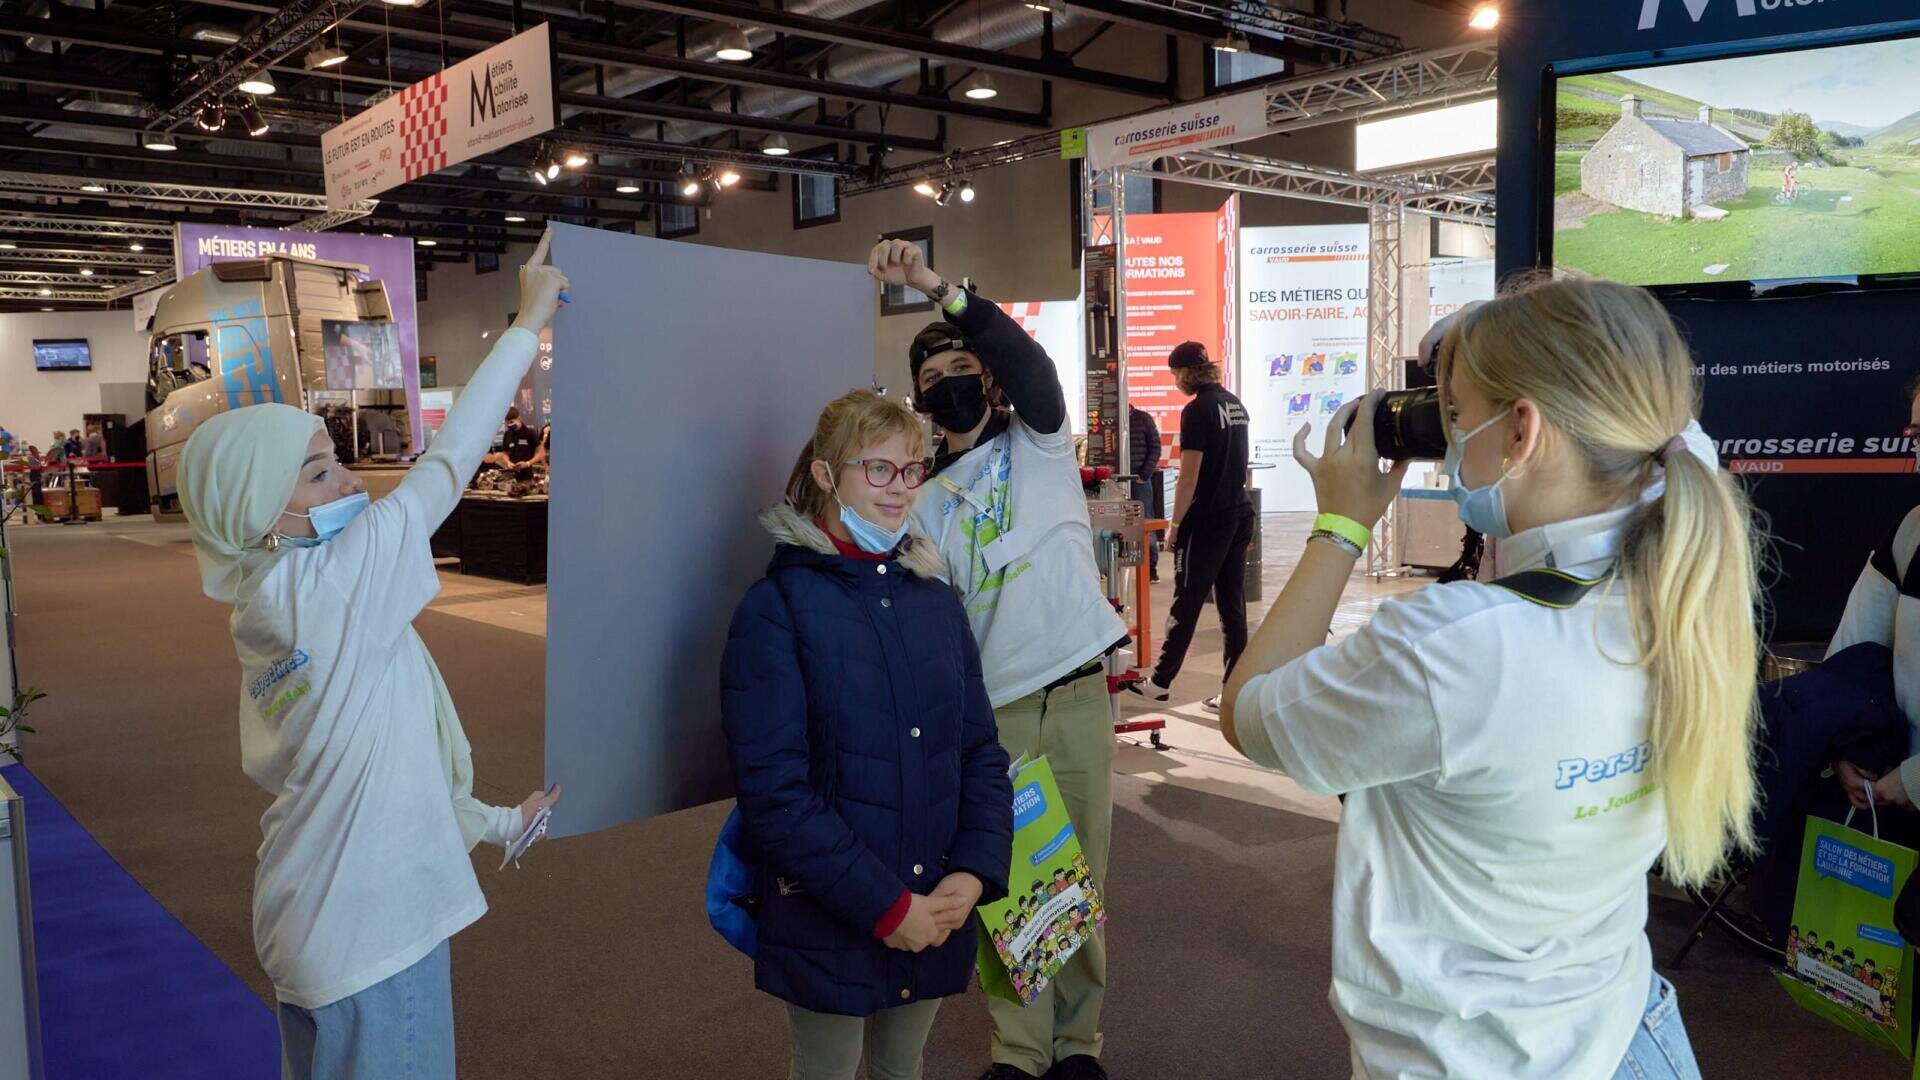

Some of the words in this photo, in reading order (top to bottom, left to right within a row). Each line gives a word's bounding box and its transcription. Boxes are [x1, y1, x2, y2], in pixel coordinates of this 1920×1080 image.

[332, 142, 350, 161] FUTUR
[350, 135, 361, 152] EST
[361, 132, 370, 147] EN
[370, 119, 396, 141] ROUTES
[1115, 121, 1178, 147] carrosserie
[1180, 113, 1220, 133] suisse
[198, 235, 257, 258] MÉTIERS
[258, 241, 276, 255] EN
[290, 243, 316, 260] ANS
[1250, 243, 1316, 255] carrosserie
[1319, 240, 1358, 253] suisse
[1125, 257, 1156, 267] UTES
[1158, 256, 1184, 267] NOS
[1125, 268, 1185, 279] RMATIONS
[1249, 290, 1277, 304] DES
[1280, 286, 1343, 302] MÉTIERS
[1347, 288, 1369, 300] QU
[1710, 363, 1738, 376] des
[1742, 360, 1803, 375] métiers
[1807, 357, 1891, 373] motorisés
[221, 346, 286, 409] FH
[1713, 432, 1856, 455] rrosserie
[1736, 461, 1784, 473] VAUD
[1013, 787, 1036, 807] TIERS
[1574, 806, 1599, 820] Le
[1818, 849, 1826, 859] ET
[1827, 853, 1837, 864] DE
[1838, 857, 1849, 868] LA
[1849, 860, 1889, 884] FORMATION
[1819, 839, 1841, 855] SALON
[1843, 848, 1858, 860] DES
[1858, 853, 1889, 873] MÉTIERS
[1817, 858, 1853, 880] LAUSANNE
